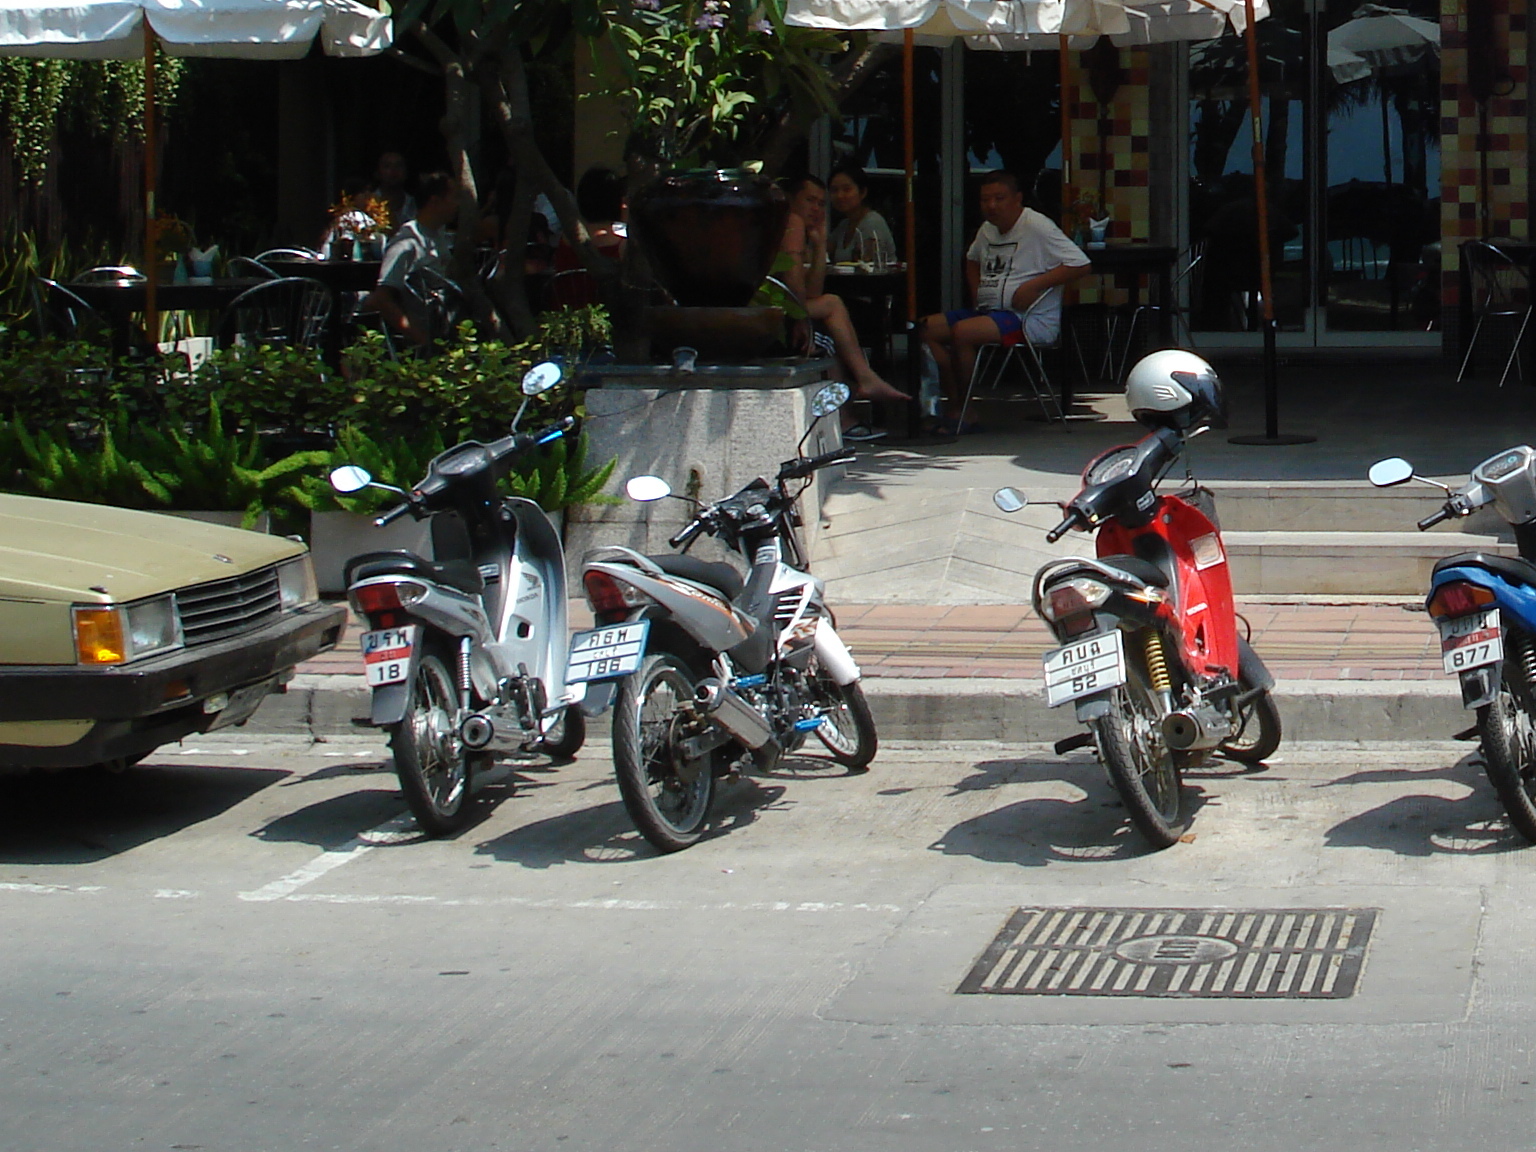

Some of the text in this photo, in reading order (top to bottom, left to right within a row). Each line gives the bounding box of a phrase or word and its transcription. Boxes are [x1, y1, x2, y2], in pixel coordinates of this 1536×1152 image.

[1453, 644, 1490, 667] 877
[378, 663, 400, 682] 18
[587, 657, 621, 677] 186
[1073, 672, 1098, 694] 52
